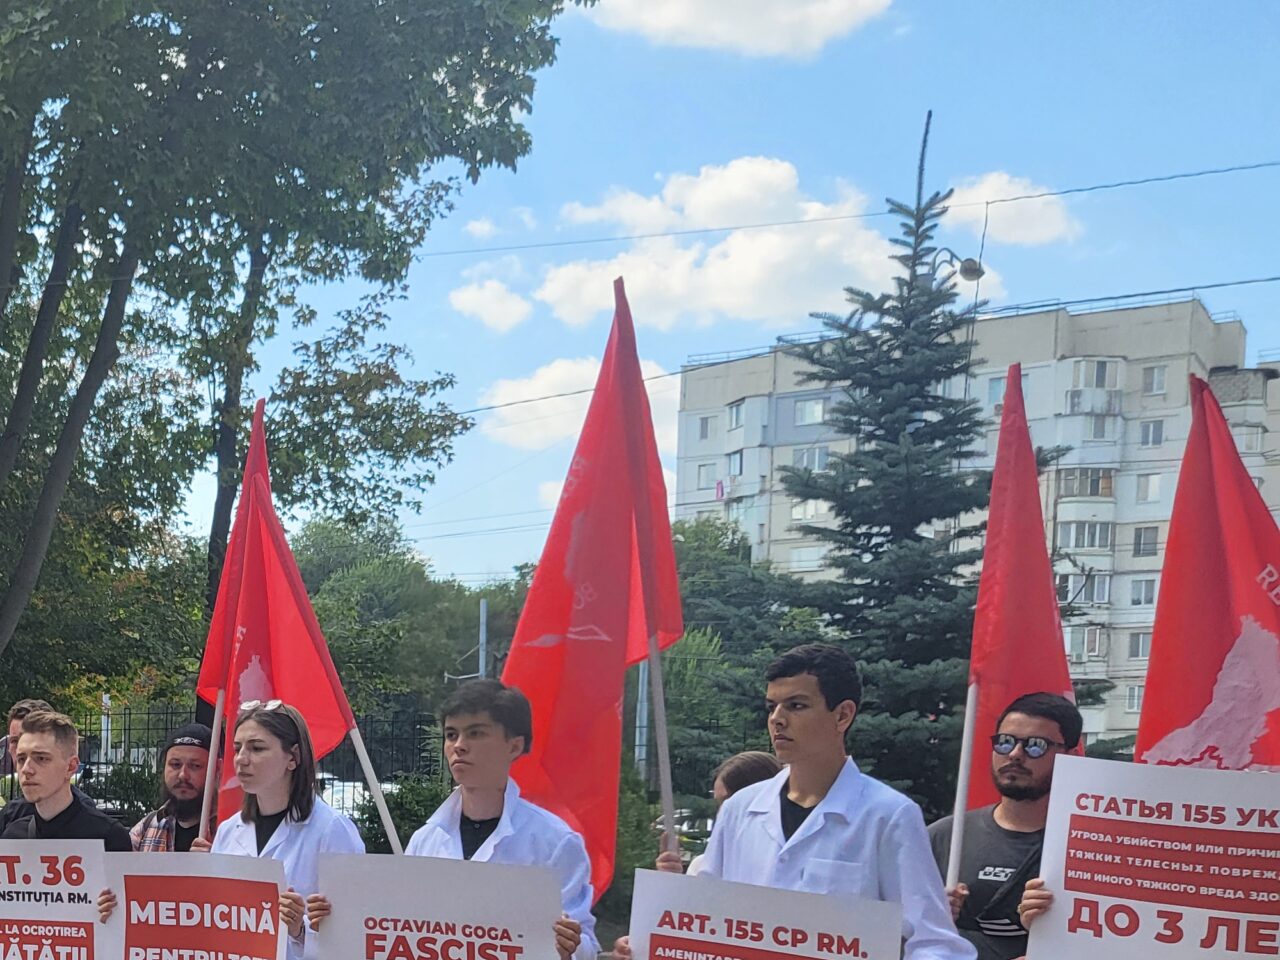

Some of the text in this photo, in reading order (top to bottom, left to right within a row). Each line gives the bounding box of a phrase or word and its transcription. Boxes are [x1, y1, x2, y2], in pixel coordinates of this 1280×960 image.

[1075, 793, 1280, 828] СТАТЬЯ 155 УК
[1071, 829, 1112, 844] УГРОЗА
[1116, 835, 1192, 852] УБИЙСТВОМ
[1195, 844, 1224, 855] ИЛИ
[40, 855, 85, 887] 36
[1069, 849, 1280, 880] ТЯЖКИХ ТЕЛЕСНЫХ ПОВРЕЖ
[67, 892, 92, 905] RM.
[1067, 869, 1091, 881] ИЛИ
[1094, 874, 1133, 886] ИНОГО
[1136, 879, 1196, 894] ТЯЖКОГО
[1199, 886, 1245, 900] ВРЕДА
[5, 924, 20, 935] LA
[22, 925, 87, 938] OCROTIREA
[130, 900, 276, 936] MEDICINĂ
[363, 917, 457, 937] OCTAVIAN
[461, 924, 512, 943] GOGA
[1067, 898, 1280, 955] ДО 3 ЛЕ
[657, 910, 869, 959] ART. 155 CP RM.
